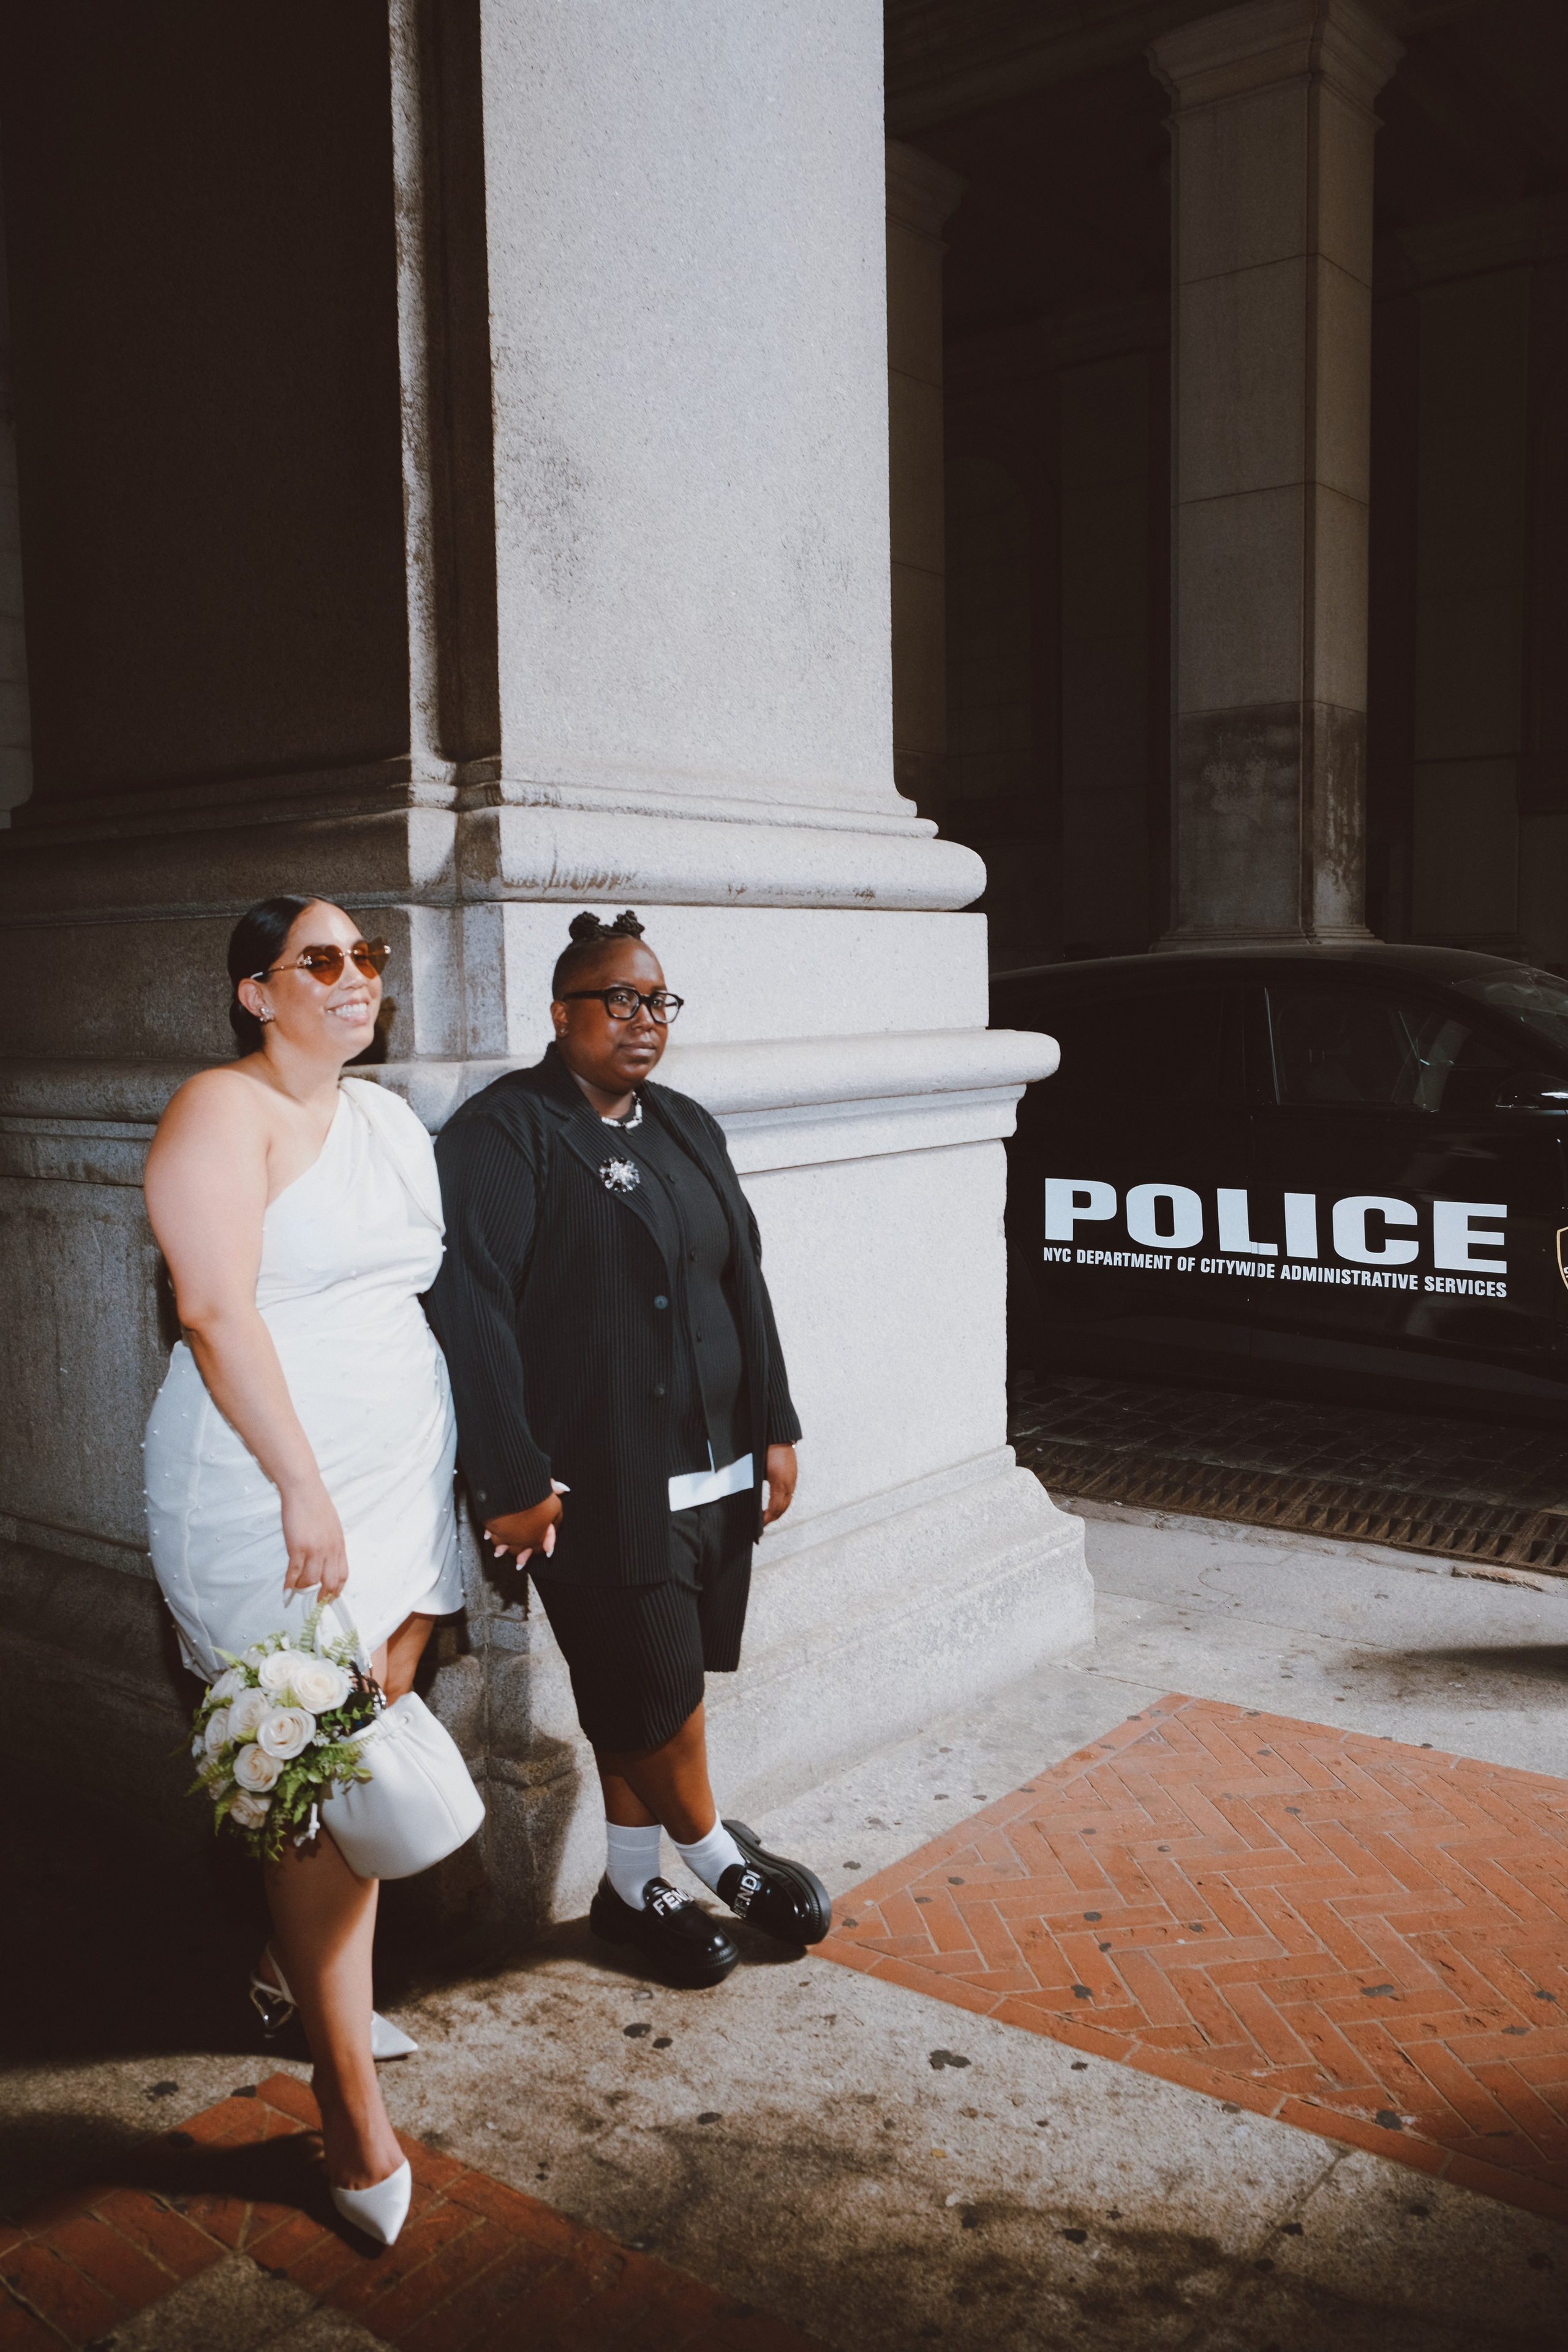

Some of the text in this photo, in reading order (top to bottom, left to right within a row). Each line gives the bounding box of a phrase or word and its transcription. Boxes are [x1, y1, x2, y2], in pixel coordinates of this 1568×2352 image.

[1045, 1177, 1507, 1274] POLICE
[1043, 1246, 1507, 1298] NYC DEPARTMENT OF CITYWIDE ADMINISTRATIVE SERVICES
